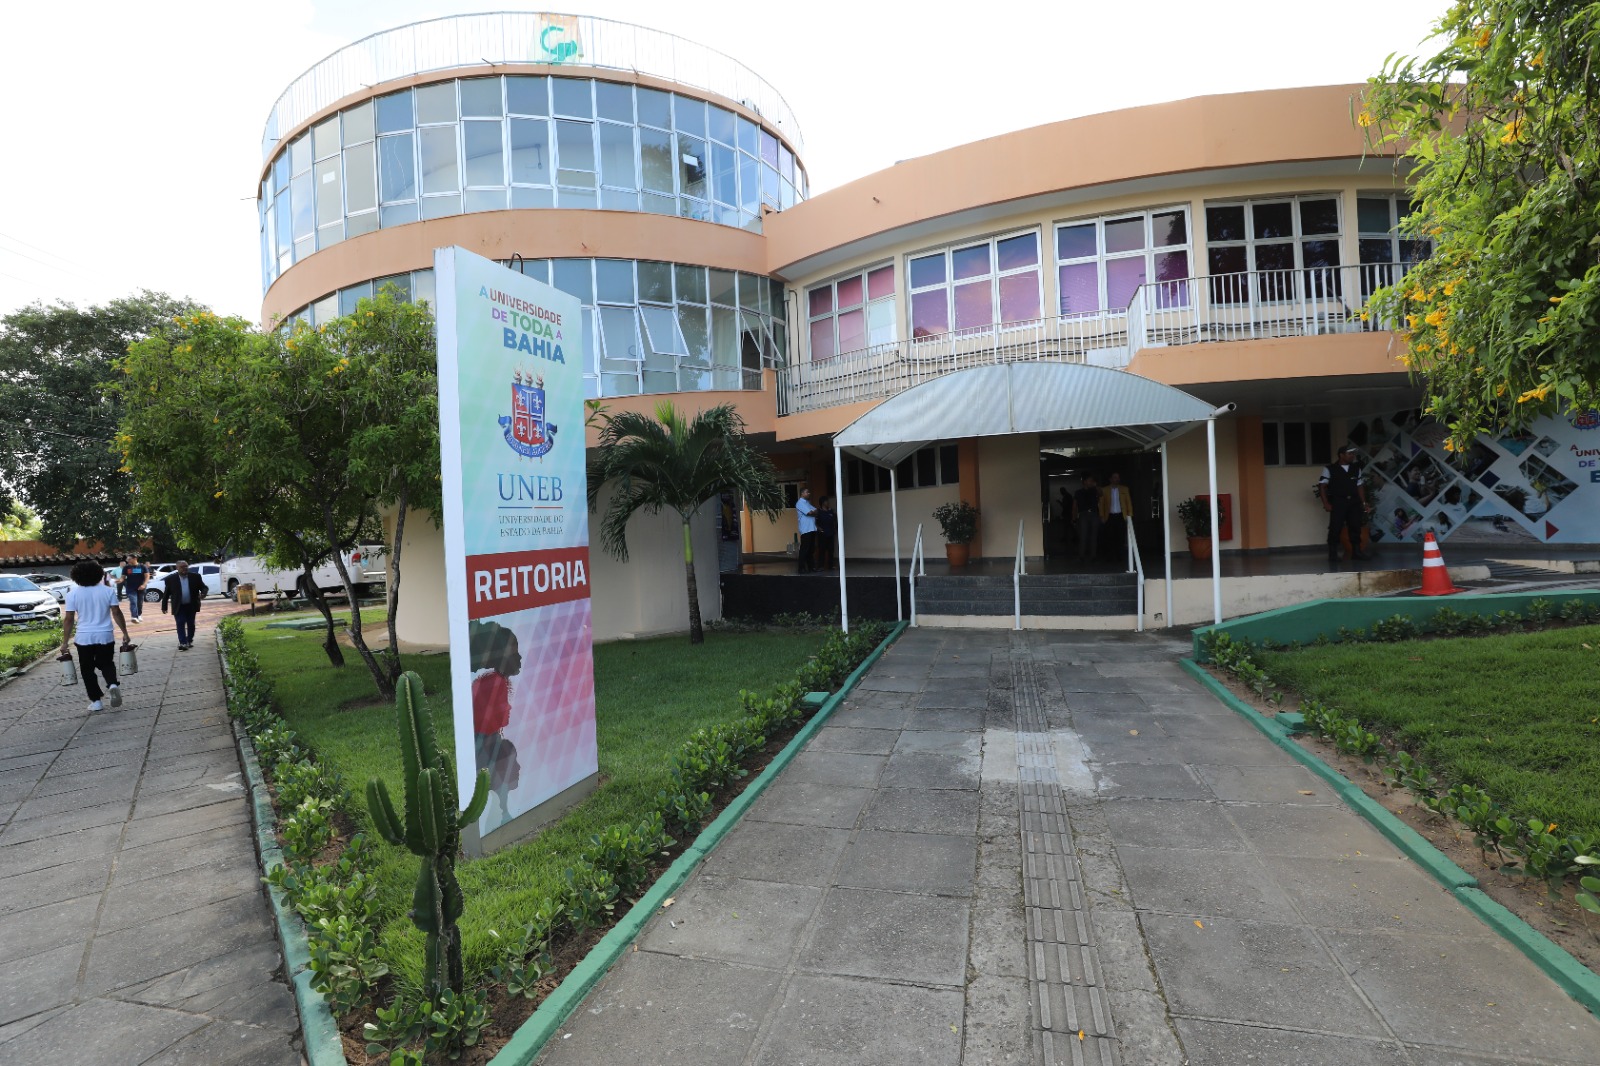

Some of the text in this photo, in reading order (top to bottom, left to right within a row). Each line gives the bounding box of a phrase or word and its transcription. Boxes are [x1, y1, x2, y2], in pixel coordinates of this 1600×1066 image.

[479, 285, 562, 326] A UNIVERSIDADE
[491, 307, 562, 340] DE TODA A
[503, 327, 566, 365] BAHIA
[1578, 460, 1595, 468] DE
[497, 473, 564, 502] UNEB
[498, 514, 564, 524] UNIVERSIDADE DO
[500, 526, 564, 537] ESTADO DA BAHIA
[473, 559, 587, 603] REITORIA
